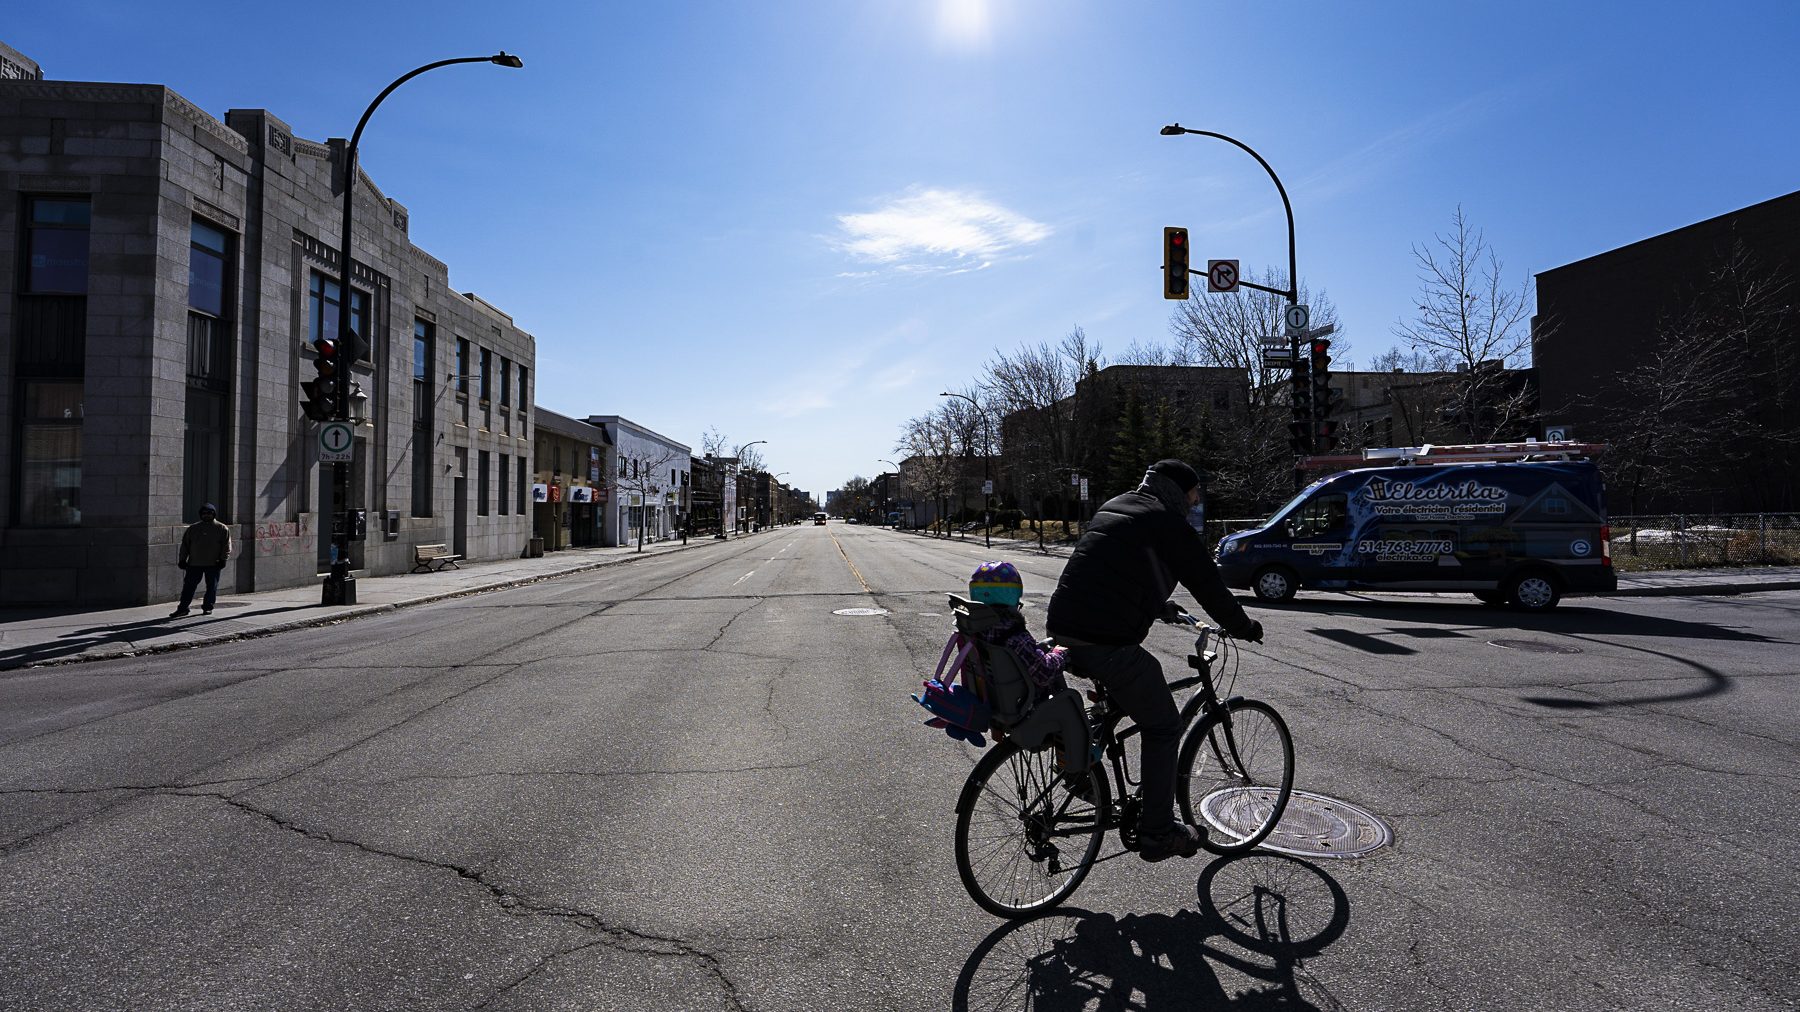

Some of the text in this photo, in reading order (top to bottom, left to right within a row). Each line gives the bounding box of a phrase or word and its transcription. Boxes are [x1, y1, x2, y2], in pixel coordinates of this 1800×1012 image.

[1389, 482, 1499, 501] Electrika
[1375, 503, 1505, 515] Votre électricien résidentiel
[1358, 540, 1453, 553] 514-768-7778
[1376, 552, 1434, 562] electrika.ca
